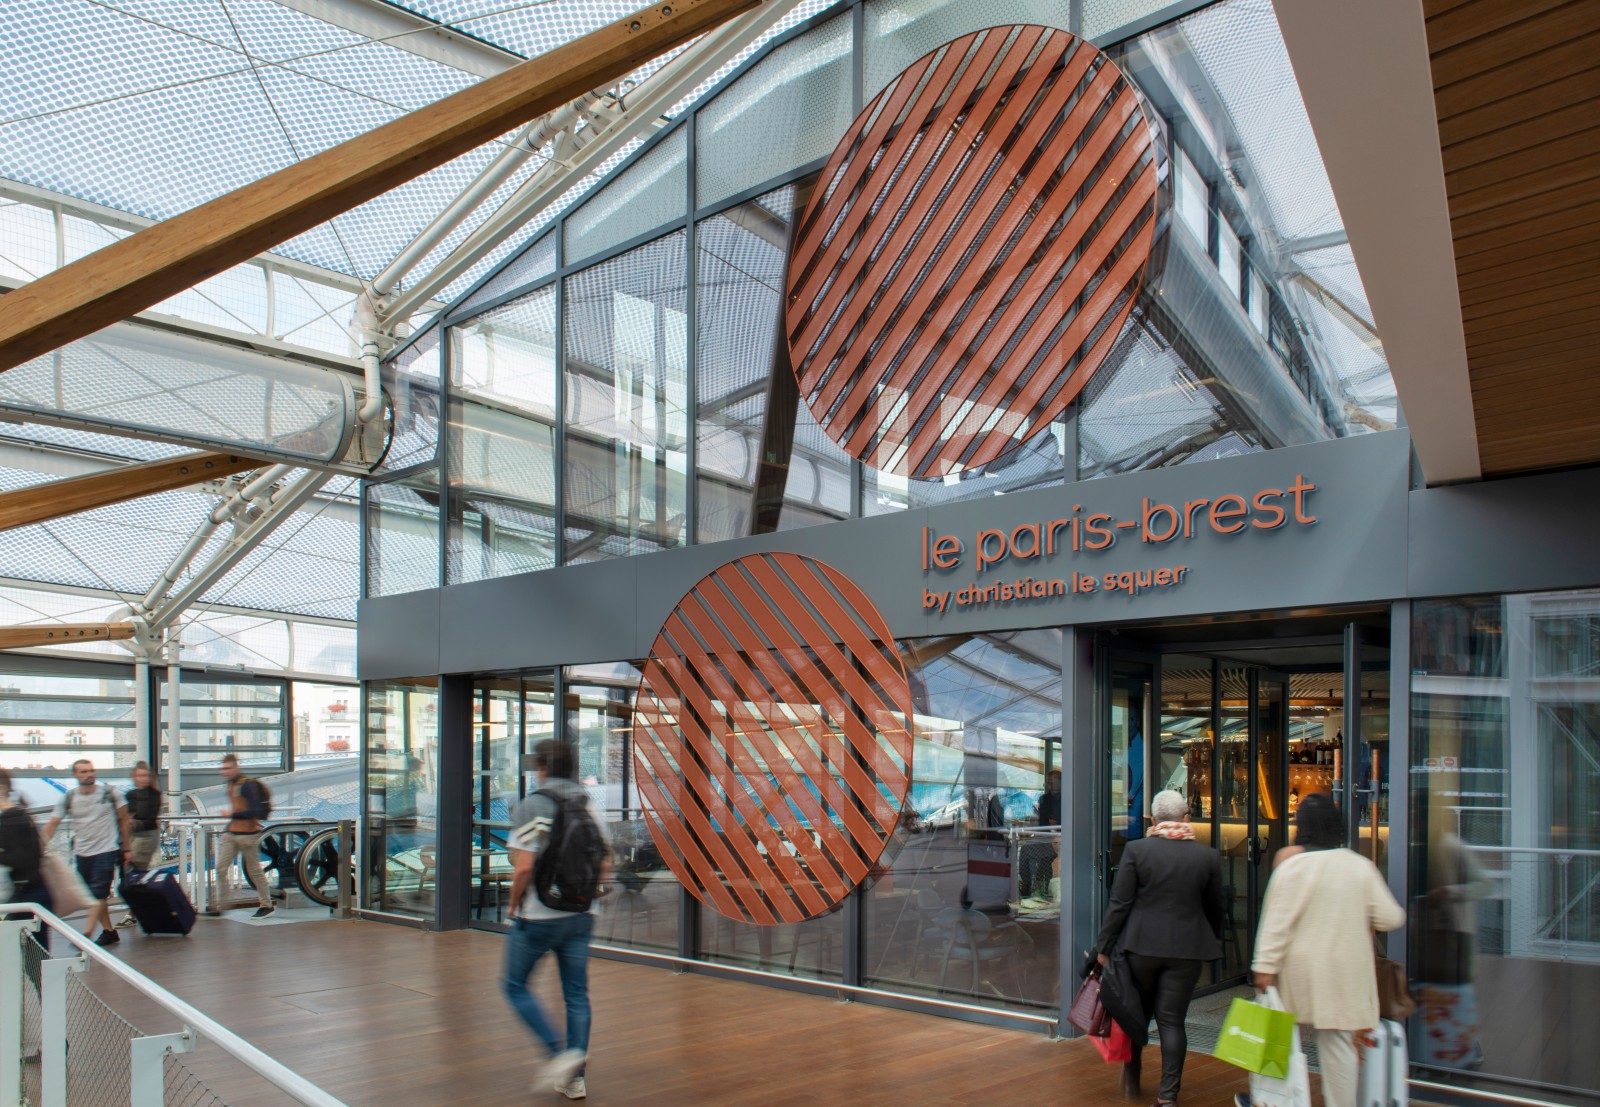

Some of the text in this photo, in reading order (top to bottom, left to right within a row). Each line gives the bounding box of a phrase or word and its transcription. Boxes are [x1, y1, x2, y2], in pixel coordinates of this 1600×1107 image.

[922, 474, 1316, 572] le paris-brest
[922, 565, 1186, 613] by christian le squer
